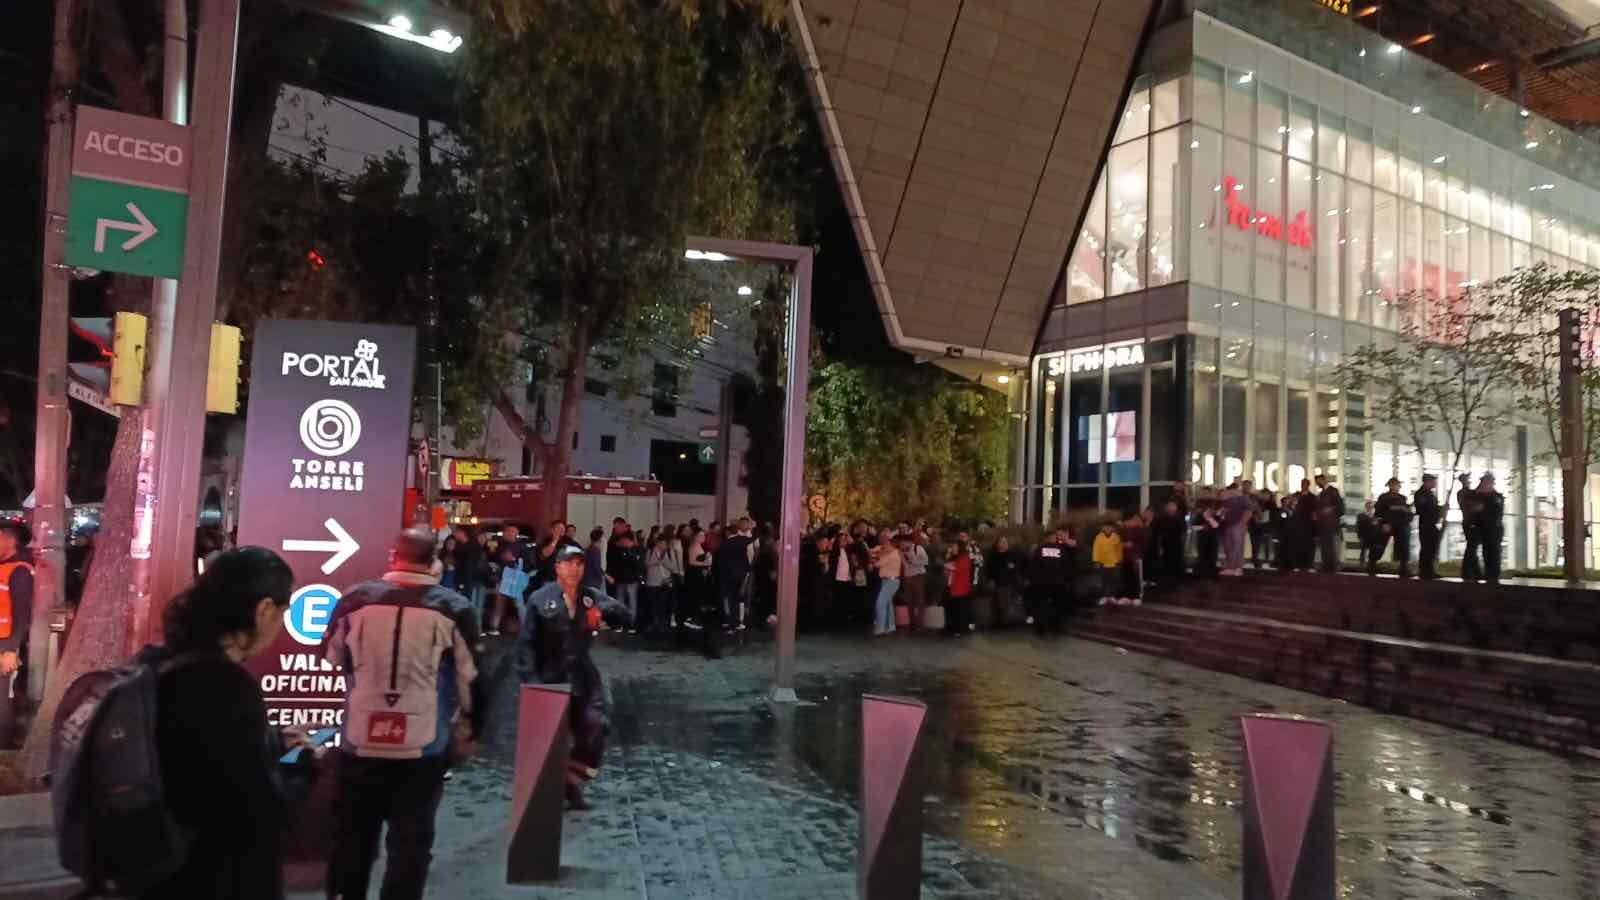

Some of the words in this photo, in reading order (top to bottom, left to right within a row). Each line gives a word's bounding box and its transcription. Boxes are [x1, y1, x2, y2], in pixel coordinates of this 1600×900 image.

[84, 130, 183, 167] ACCESO
[281, 351, 384, 379] PORTAL
[292, 458, 364, 476] TORRE
[289, 475, 363, 492] ANSELI
[302, 596, 330, 633] E
